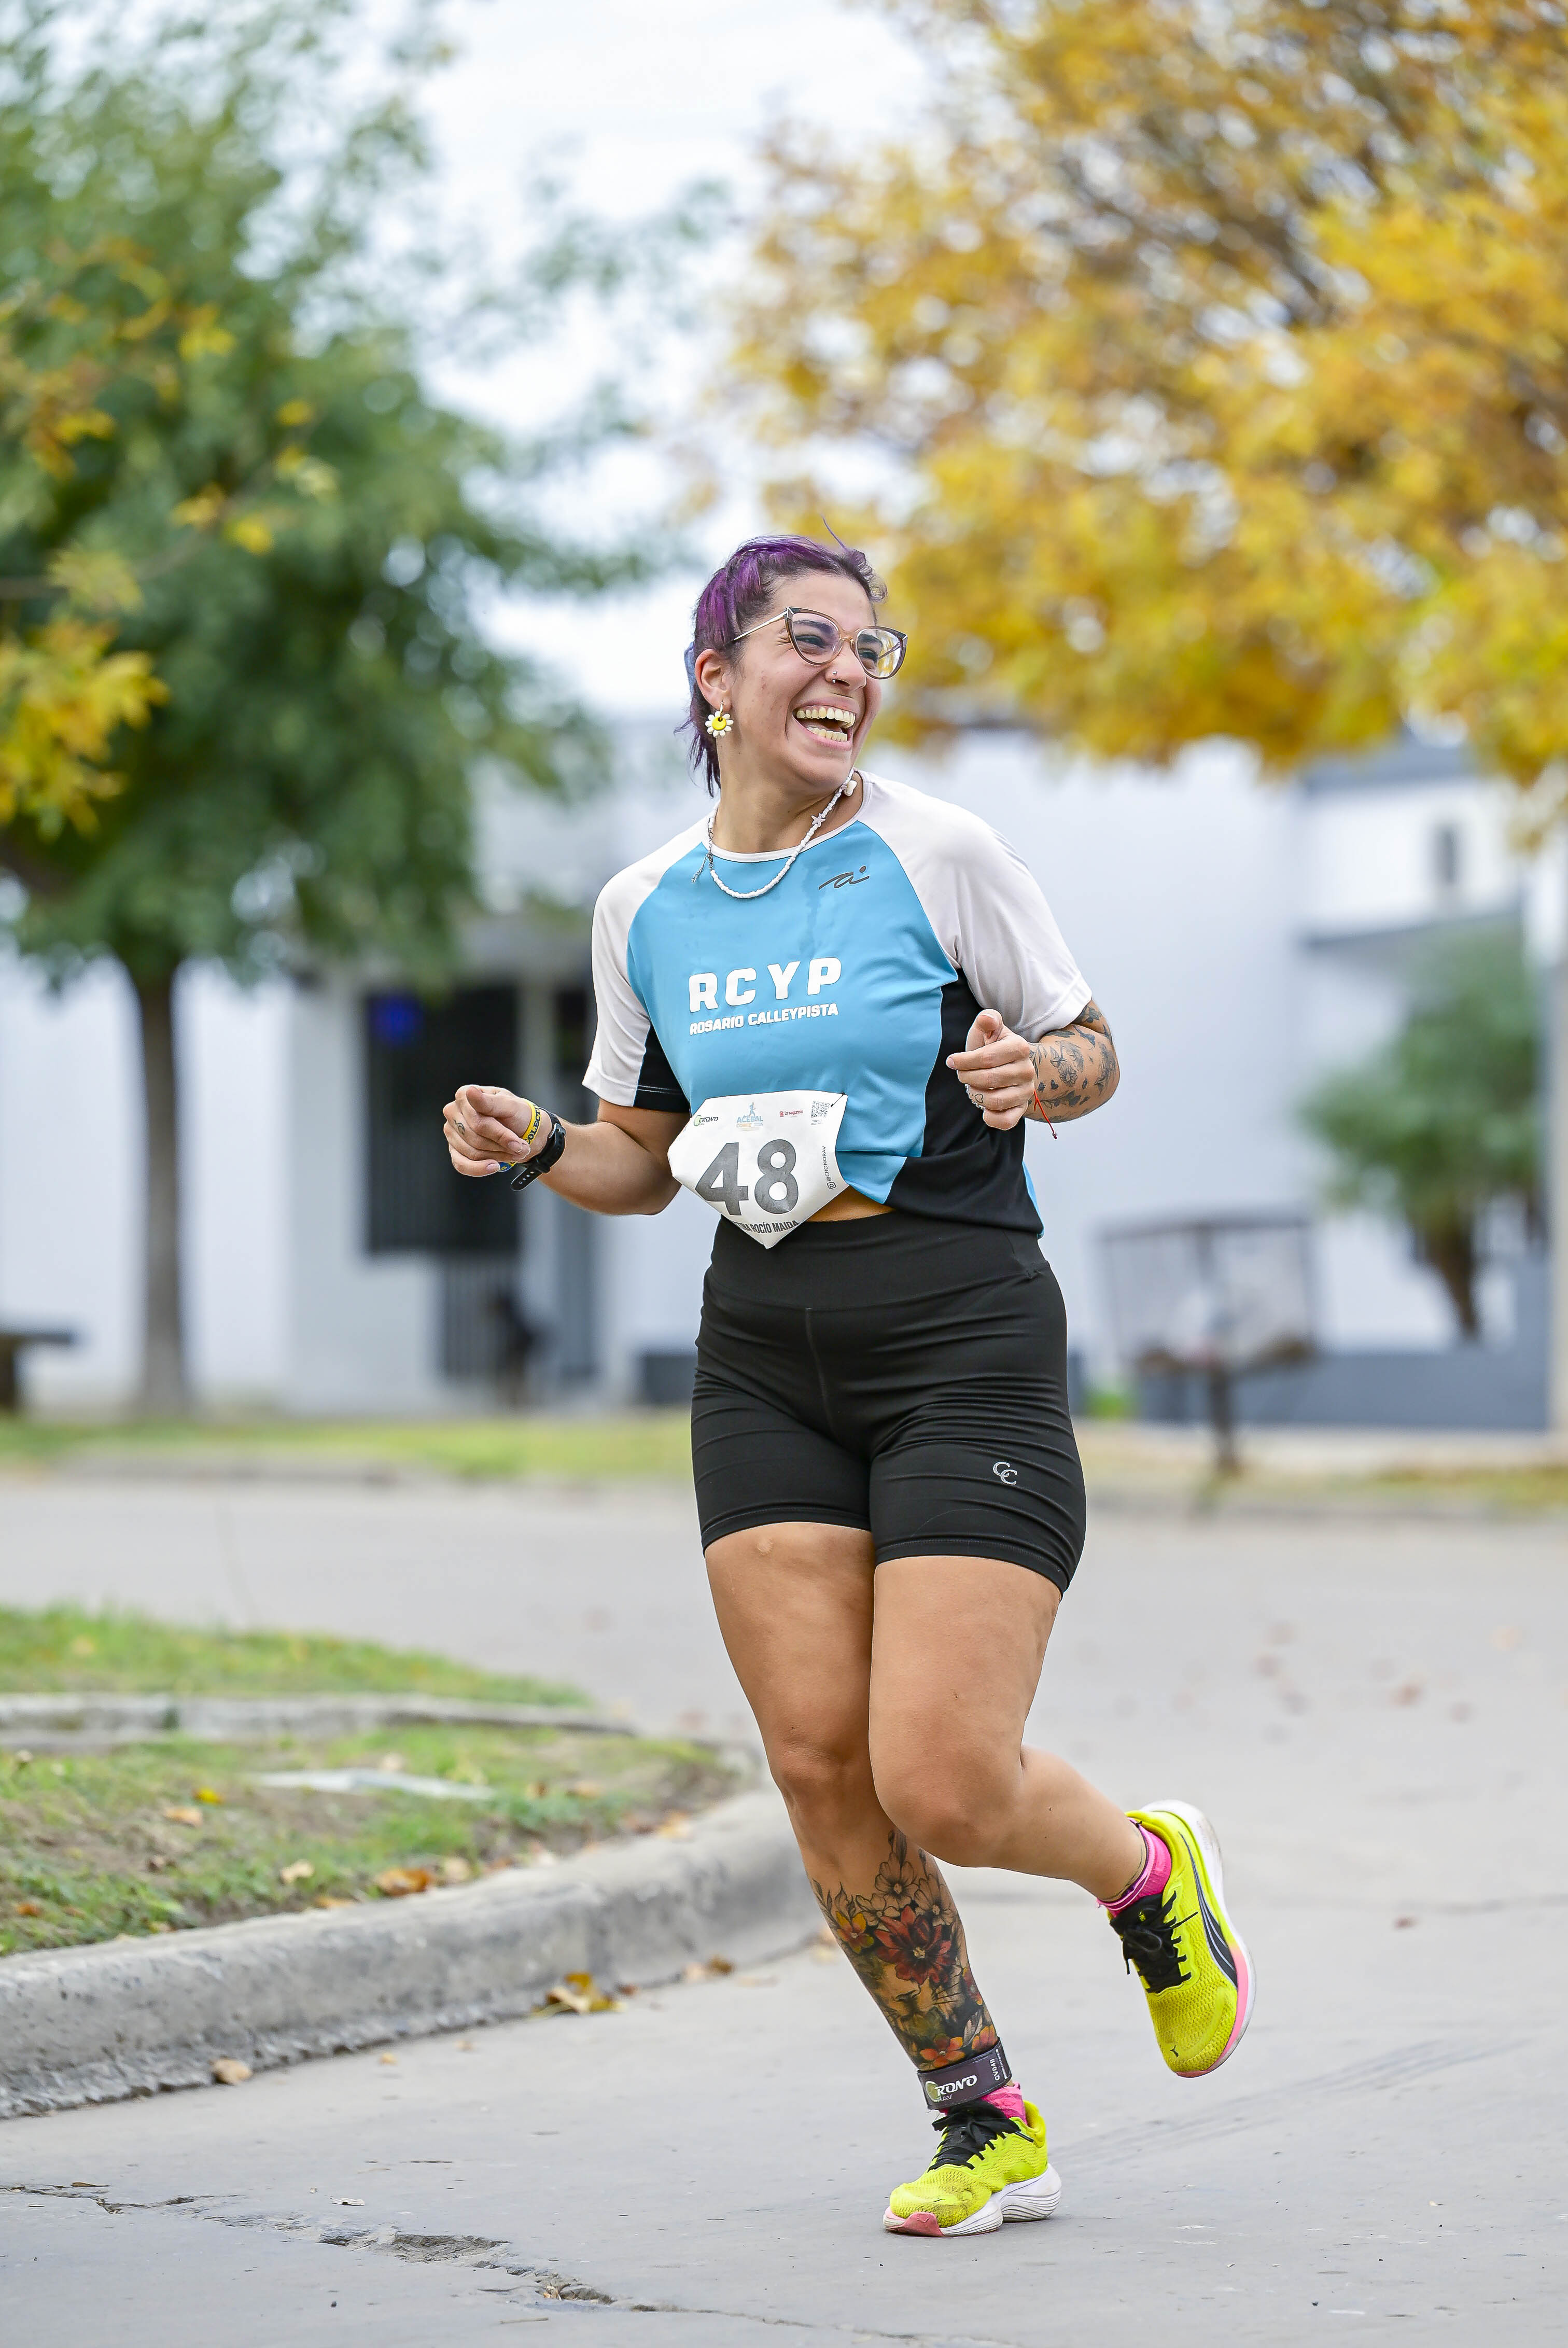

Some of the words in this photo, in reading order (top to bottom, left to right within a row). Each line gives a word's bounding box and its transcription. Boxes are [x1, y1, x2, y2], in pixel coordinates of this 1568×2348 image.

[689, 957, 842, 1013] RCYP
[690, 1016, 744, 1036] ROSARIO
[748, 1002, 839, 1026] CALLEYPISTA
[736, 1115, 763, 1123] ACEBAL
[695, 1139, 799, 1216] 48
[822, 1145, 832, 1181] @CRONORAV
[750, 1221, 772, 1234] ROCÍO
[772, 1220, 800, 1233] MAIDA
